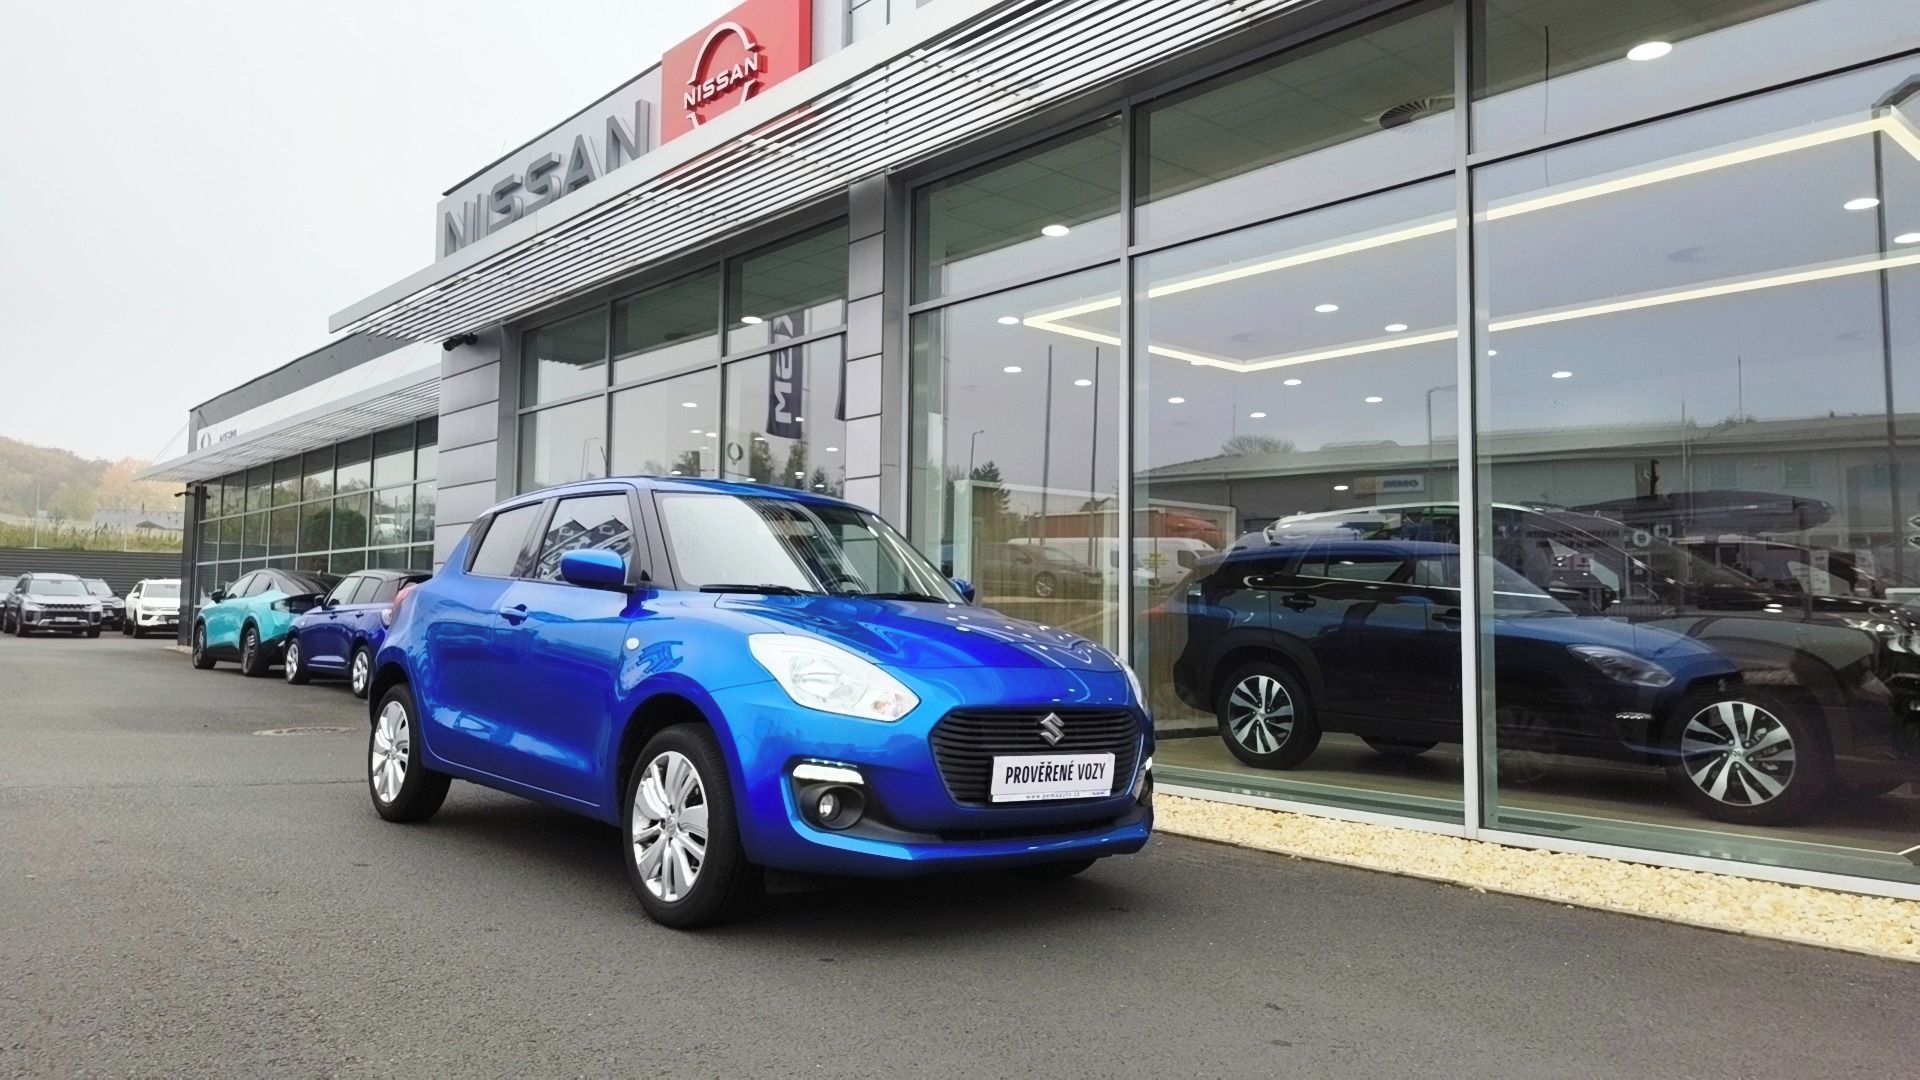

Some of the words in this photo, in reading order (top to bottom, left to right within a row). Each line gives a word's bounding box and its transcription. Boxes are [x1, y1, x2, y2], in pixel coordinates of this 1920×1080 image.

[683, 52, 758, 110] NISSAN
[444, 99, 650, 258] NISSAN
[1005, 760, 1074, 785] PROVĚŘENÉ
[1077, 762, 1106, 780] VOZY
